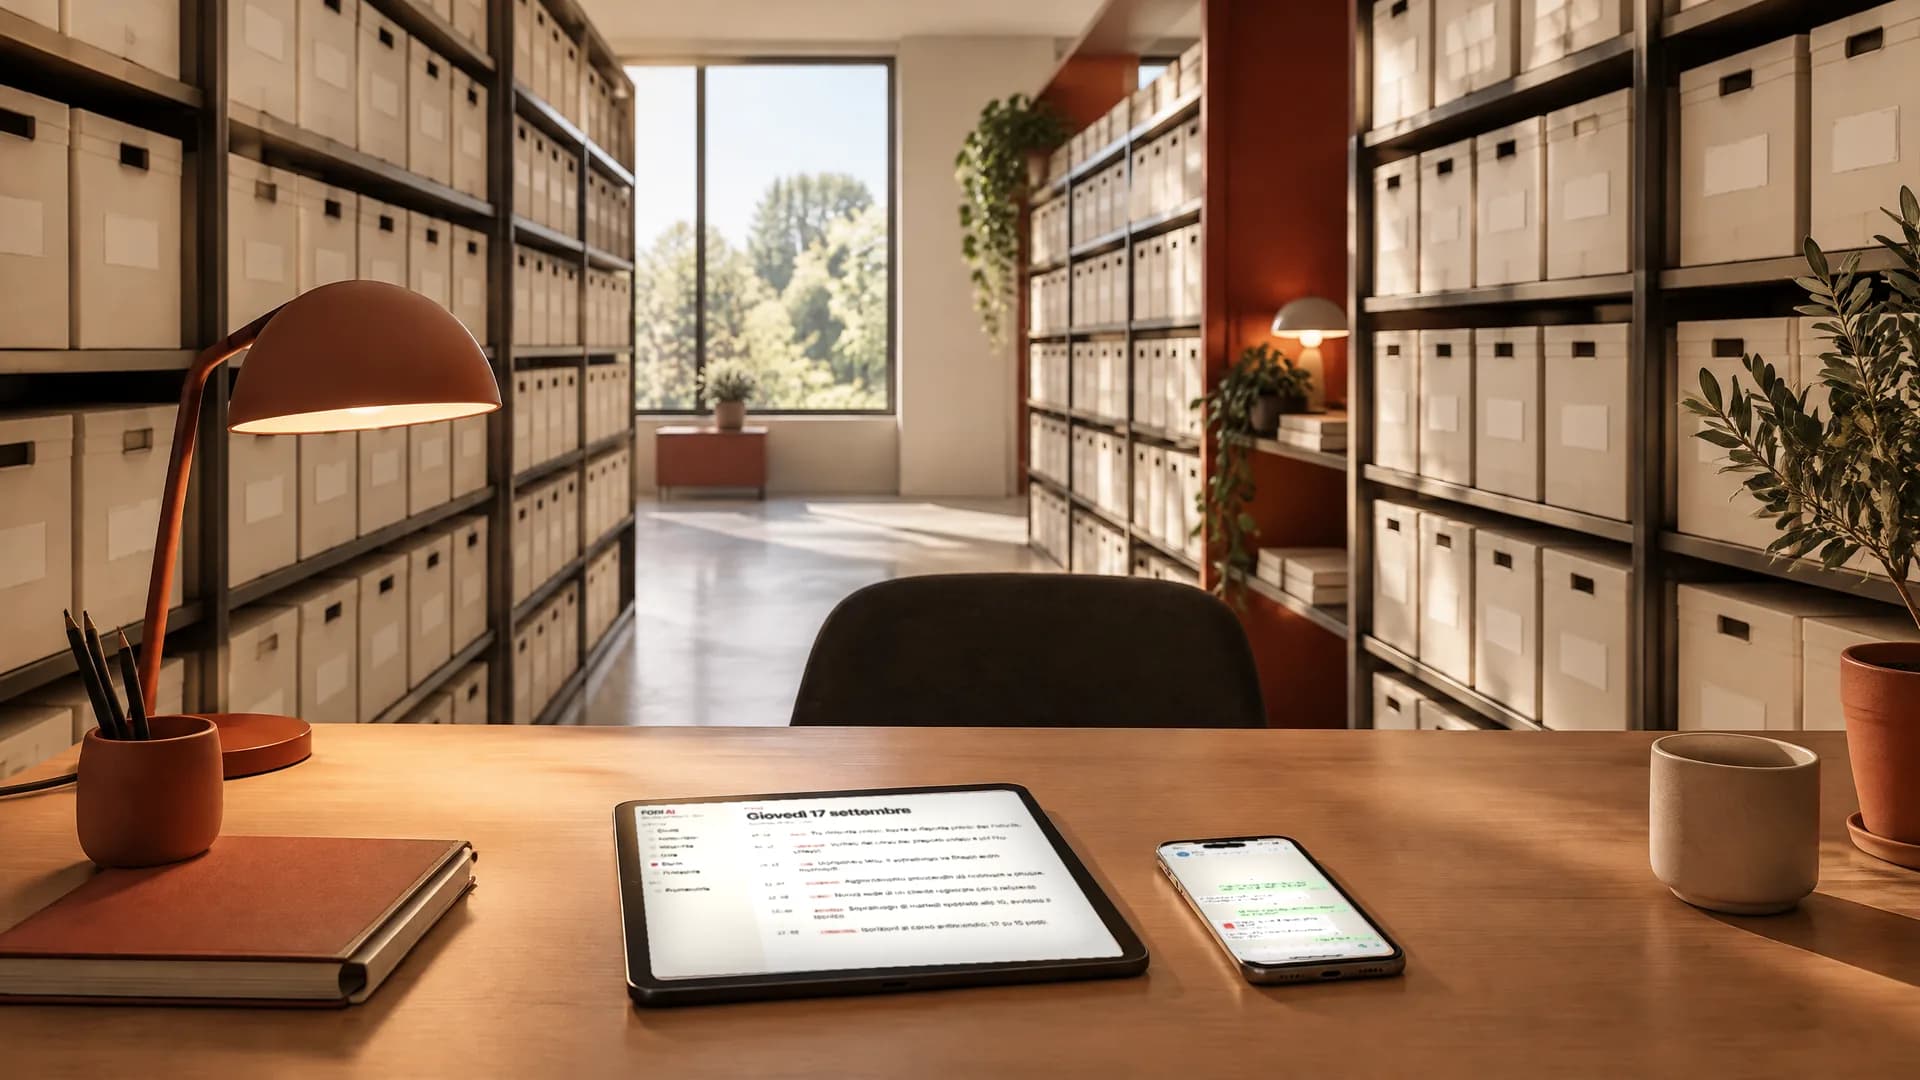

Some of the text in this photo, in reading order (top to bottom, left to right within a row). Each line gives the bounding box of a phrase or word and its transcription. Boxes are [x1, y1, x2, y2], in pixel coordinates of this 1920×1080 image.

[747, 807, 912, 821] Giovedì 17 settembre
